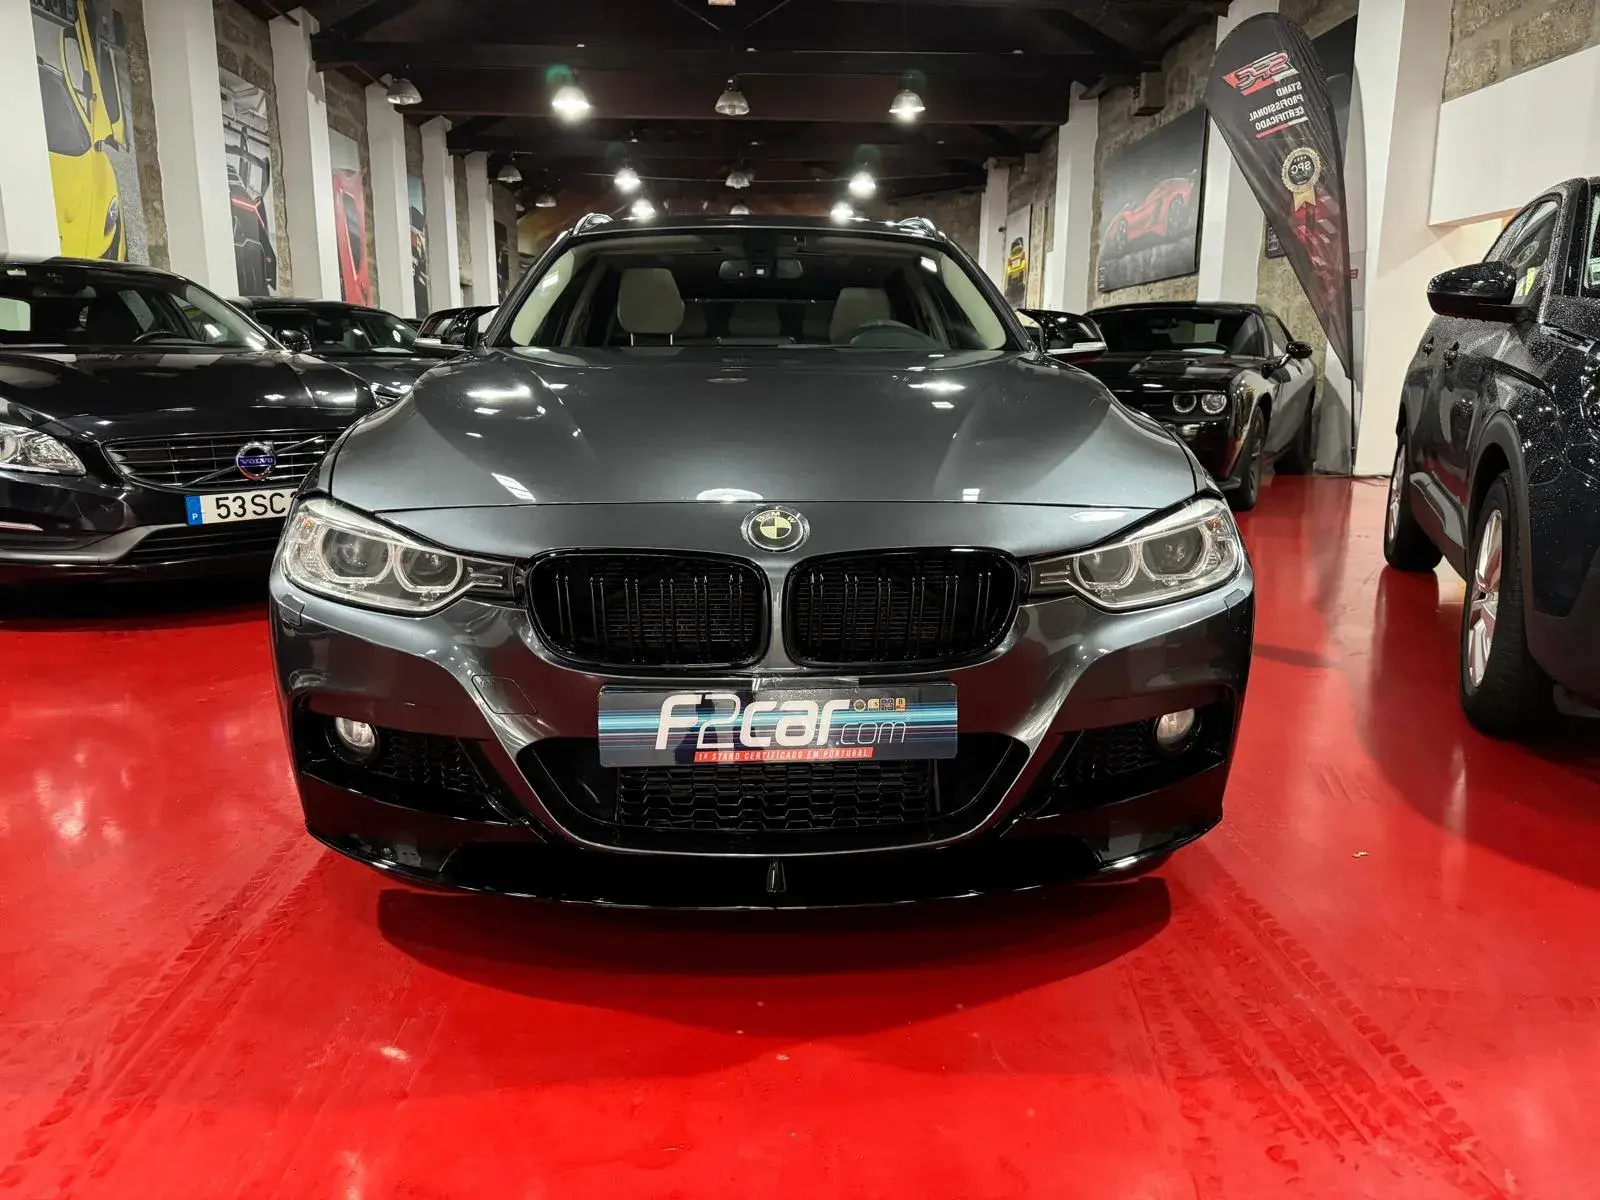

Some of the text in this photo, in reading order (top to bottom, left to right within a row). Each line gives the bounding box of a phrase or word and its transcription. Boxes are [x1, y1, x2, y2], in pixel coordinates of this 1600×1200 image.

[239, 457, 274, 465] VOLVO
[215, 490, 299, 519] 53SC
[755, 511, 797, 523] BMW
[711, 752, 740, 761] STAND
[744, 750, 803, 760] CERTIFICADO
[806, 749, 819, 759] EM
[823, 747, 868, 758] PORTUGAL
